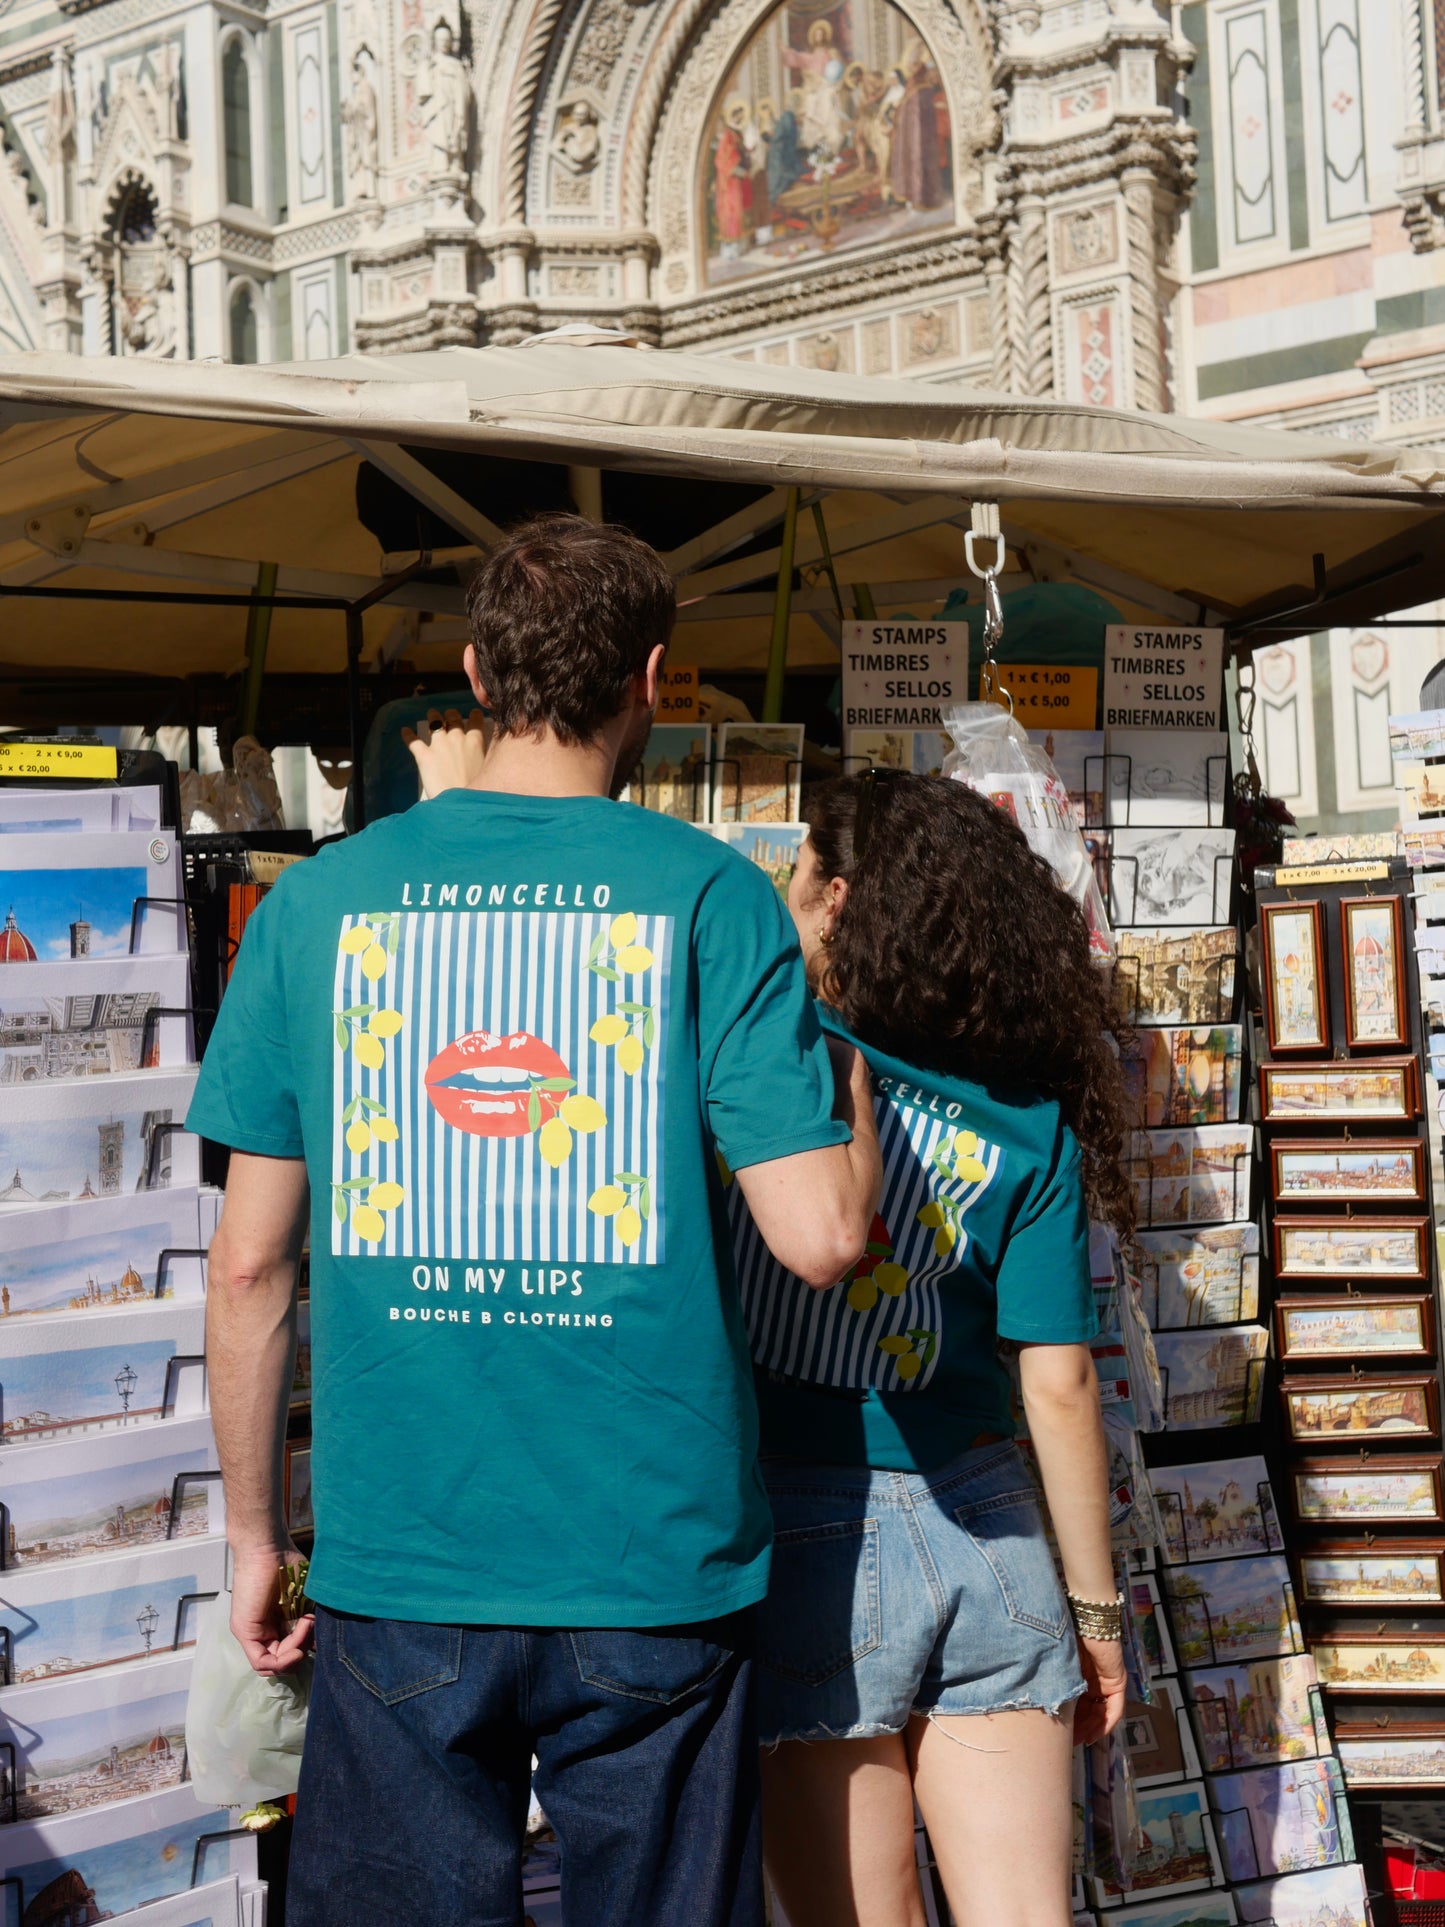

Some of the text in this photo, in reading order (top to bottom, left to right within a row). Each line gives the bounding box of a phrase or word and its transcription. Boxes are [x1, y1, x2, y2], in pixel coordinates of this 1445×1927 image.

[872, 627, 947, 645] STAMPS
[1133, 632, 1203, 650] STAMPS
[848, 654, 930, 671] TIMBRES
[1110, 657, 1185, 675] TIMBRES
[1008, 672, 1071, 686] 1 x € 1,00
[885, 681, 952, 698] SELLOS
[1143, 684, 1205, 701] SELLOS
[661, 697, 693, 711] 5,00
[1018, 697, 1026, 706] x
[1030, 695, 1038, 707] €
[1042, 696, 1070, 709] 5,00
[846, 708, 944, 725] BRIEFMARK
[1107, 708, 1216, 727] BRIEFMARKEN
[36, 749, 42, 757] 2
[64, 751, 83, 760] 9,00
[26, 764, 50, 774] 20,00
[1354, 865, 1377, 873] 20,00
[401, 883, 611, 908] LIMONCELLO
[869, 1072, 963, 1119] CELLO
[412, 1264, 583, 1296] ON MY LIPS
[389, 1307, 614, 1328] BOUCHE B CLOTHING
